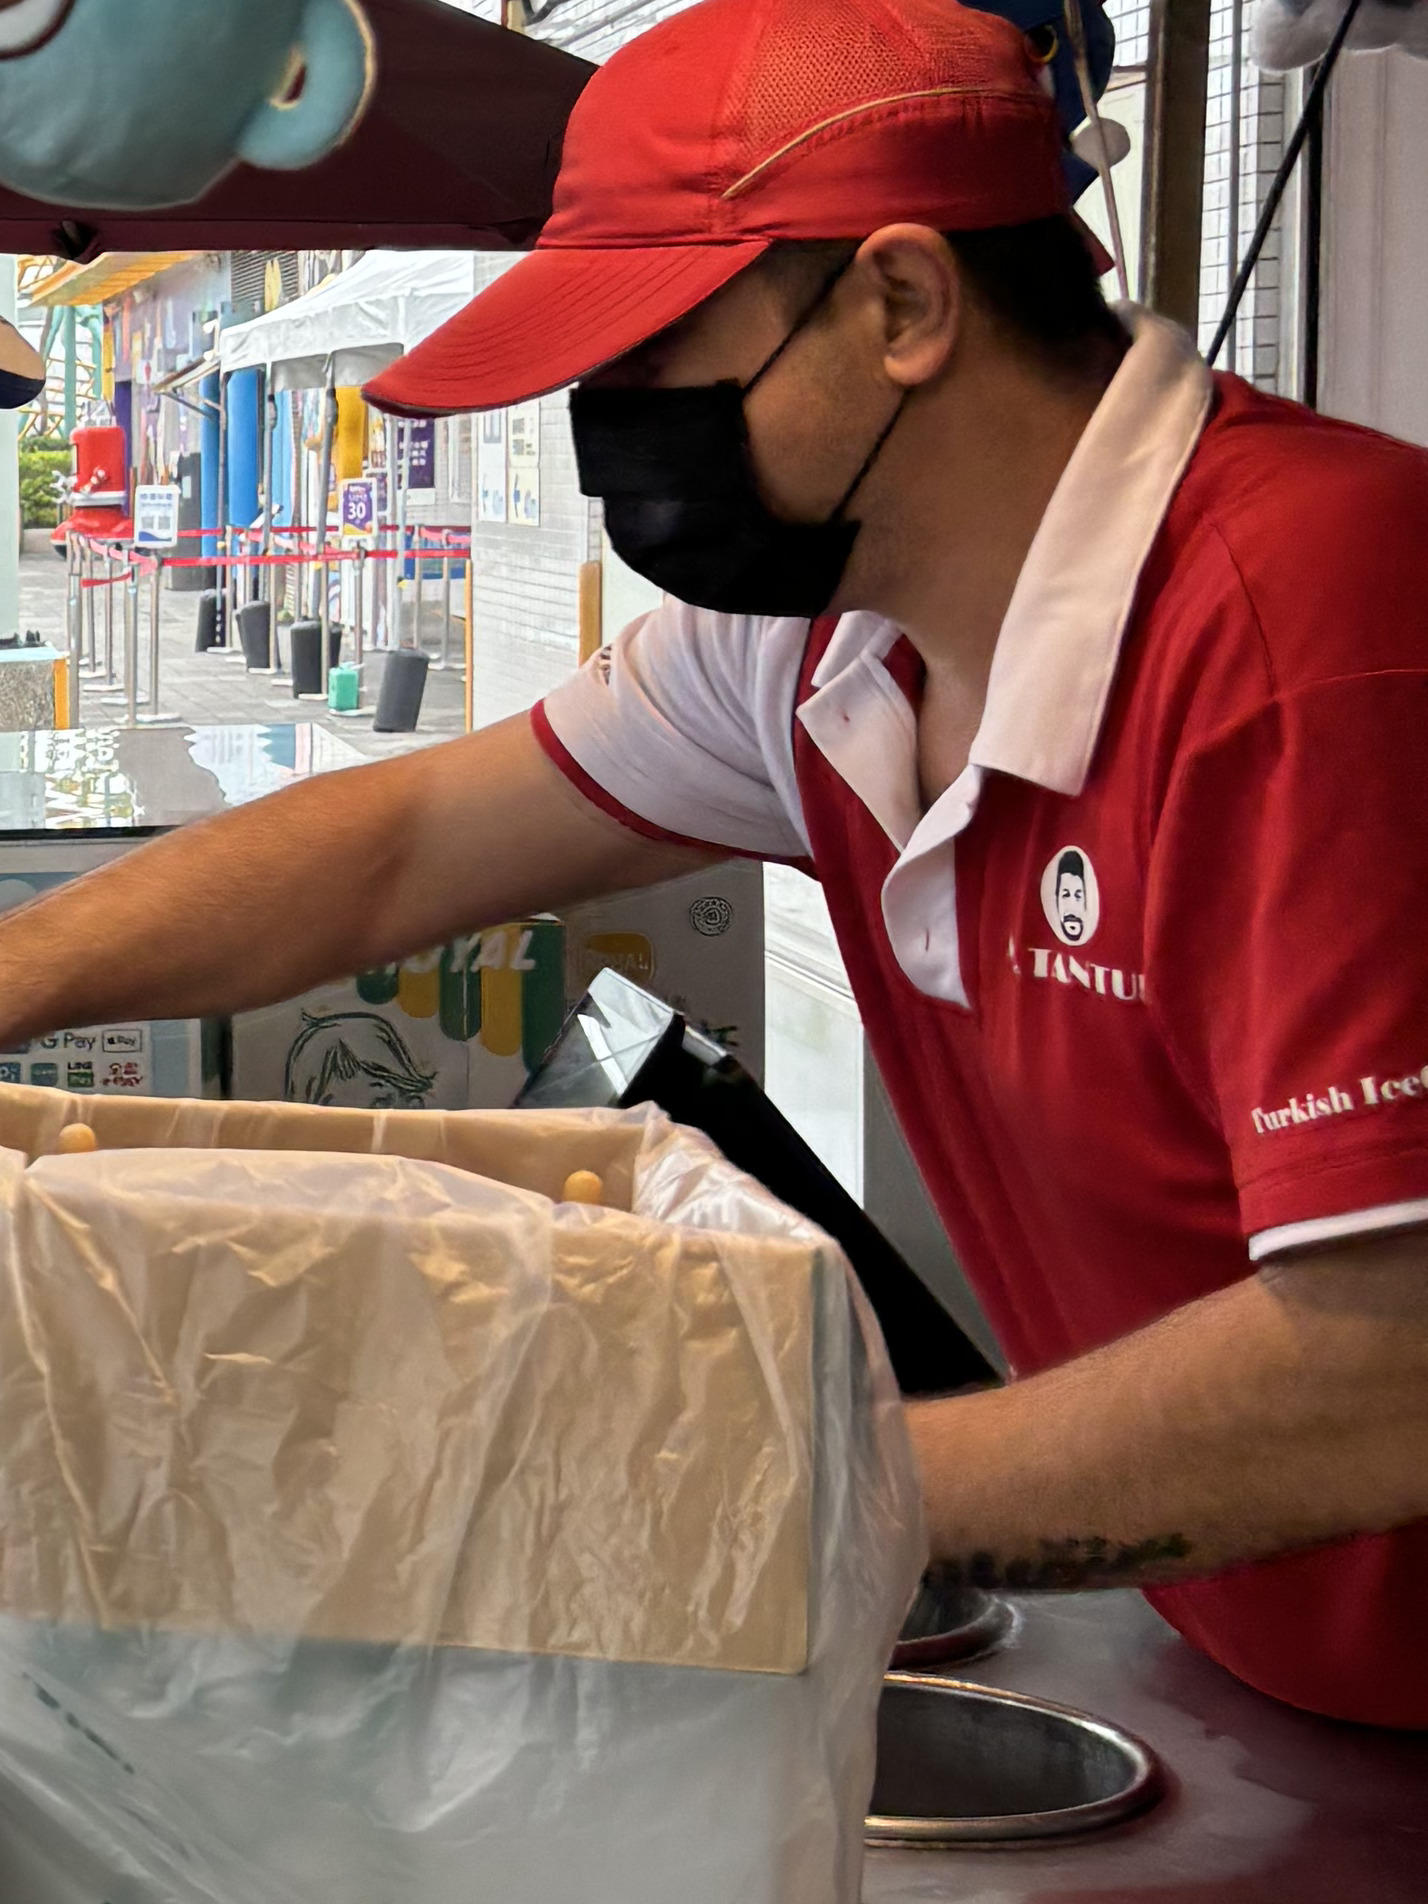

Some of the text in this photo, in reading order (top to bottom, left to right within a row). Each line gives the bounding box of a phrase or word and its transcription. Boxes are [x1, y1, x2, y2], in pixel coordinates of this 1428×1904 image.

[347, 501, 366, 520] 30
[367, 930, 537, 974] OYAL
[64, 1032, 96, 1051] Pay
[1251, 1086, 1355, 1134] Turkish
